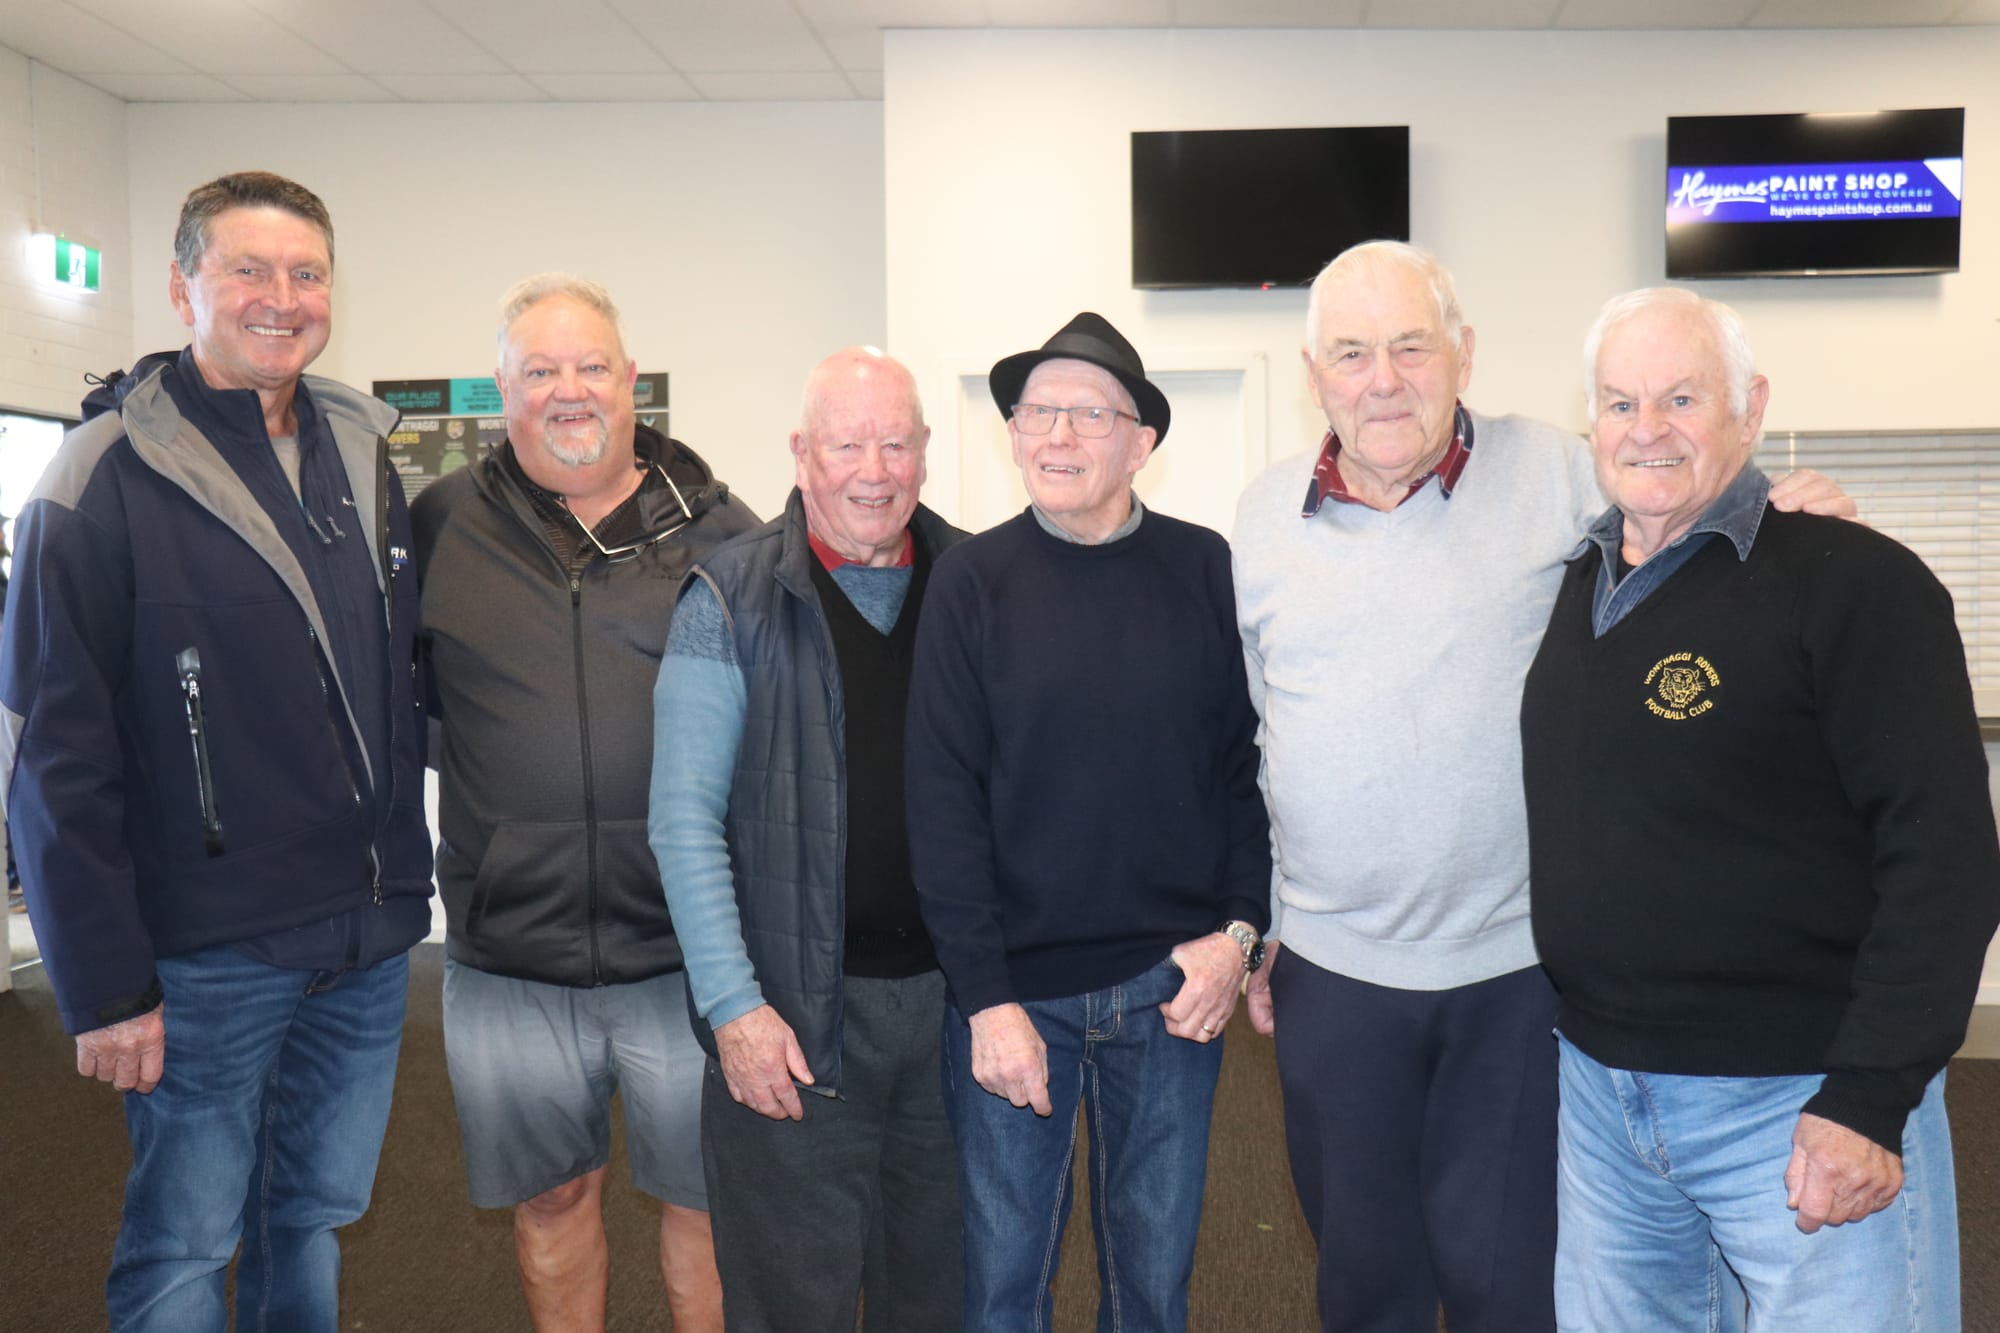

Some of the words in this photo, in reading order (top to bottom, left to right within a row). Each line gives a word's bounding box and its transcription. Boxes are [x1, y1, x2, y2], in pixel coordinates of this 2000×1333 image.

[1674, 169, 1769, 216] Haymes
[1770, 175, 1837, 192] PAINT
[1844, 173, 1908, 190] SHOP
[1770, 191, 1807, 201] WE'VE
[1814, 191, 1838, 200] GOT
[1845, 190, 1869, 199] YOU
[1874, 189, 1933, 198] COVERED
[1770, 202, 1932, 218] haymespaintshop.com.au
[1643, 652, 1692, 685] WONTHAGGI
[1694, 656, 1720, 687] ROVERS
[1644, 698, 1687, 720] FOOTBALL
[1688, 699, 1713, 717] CLUB
